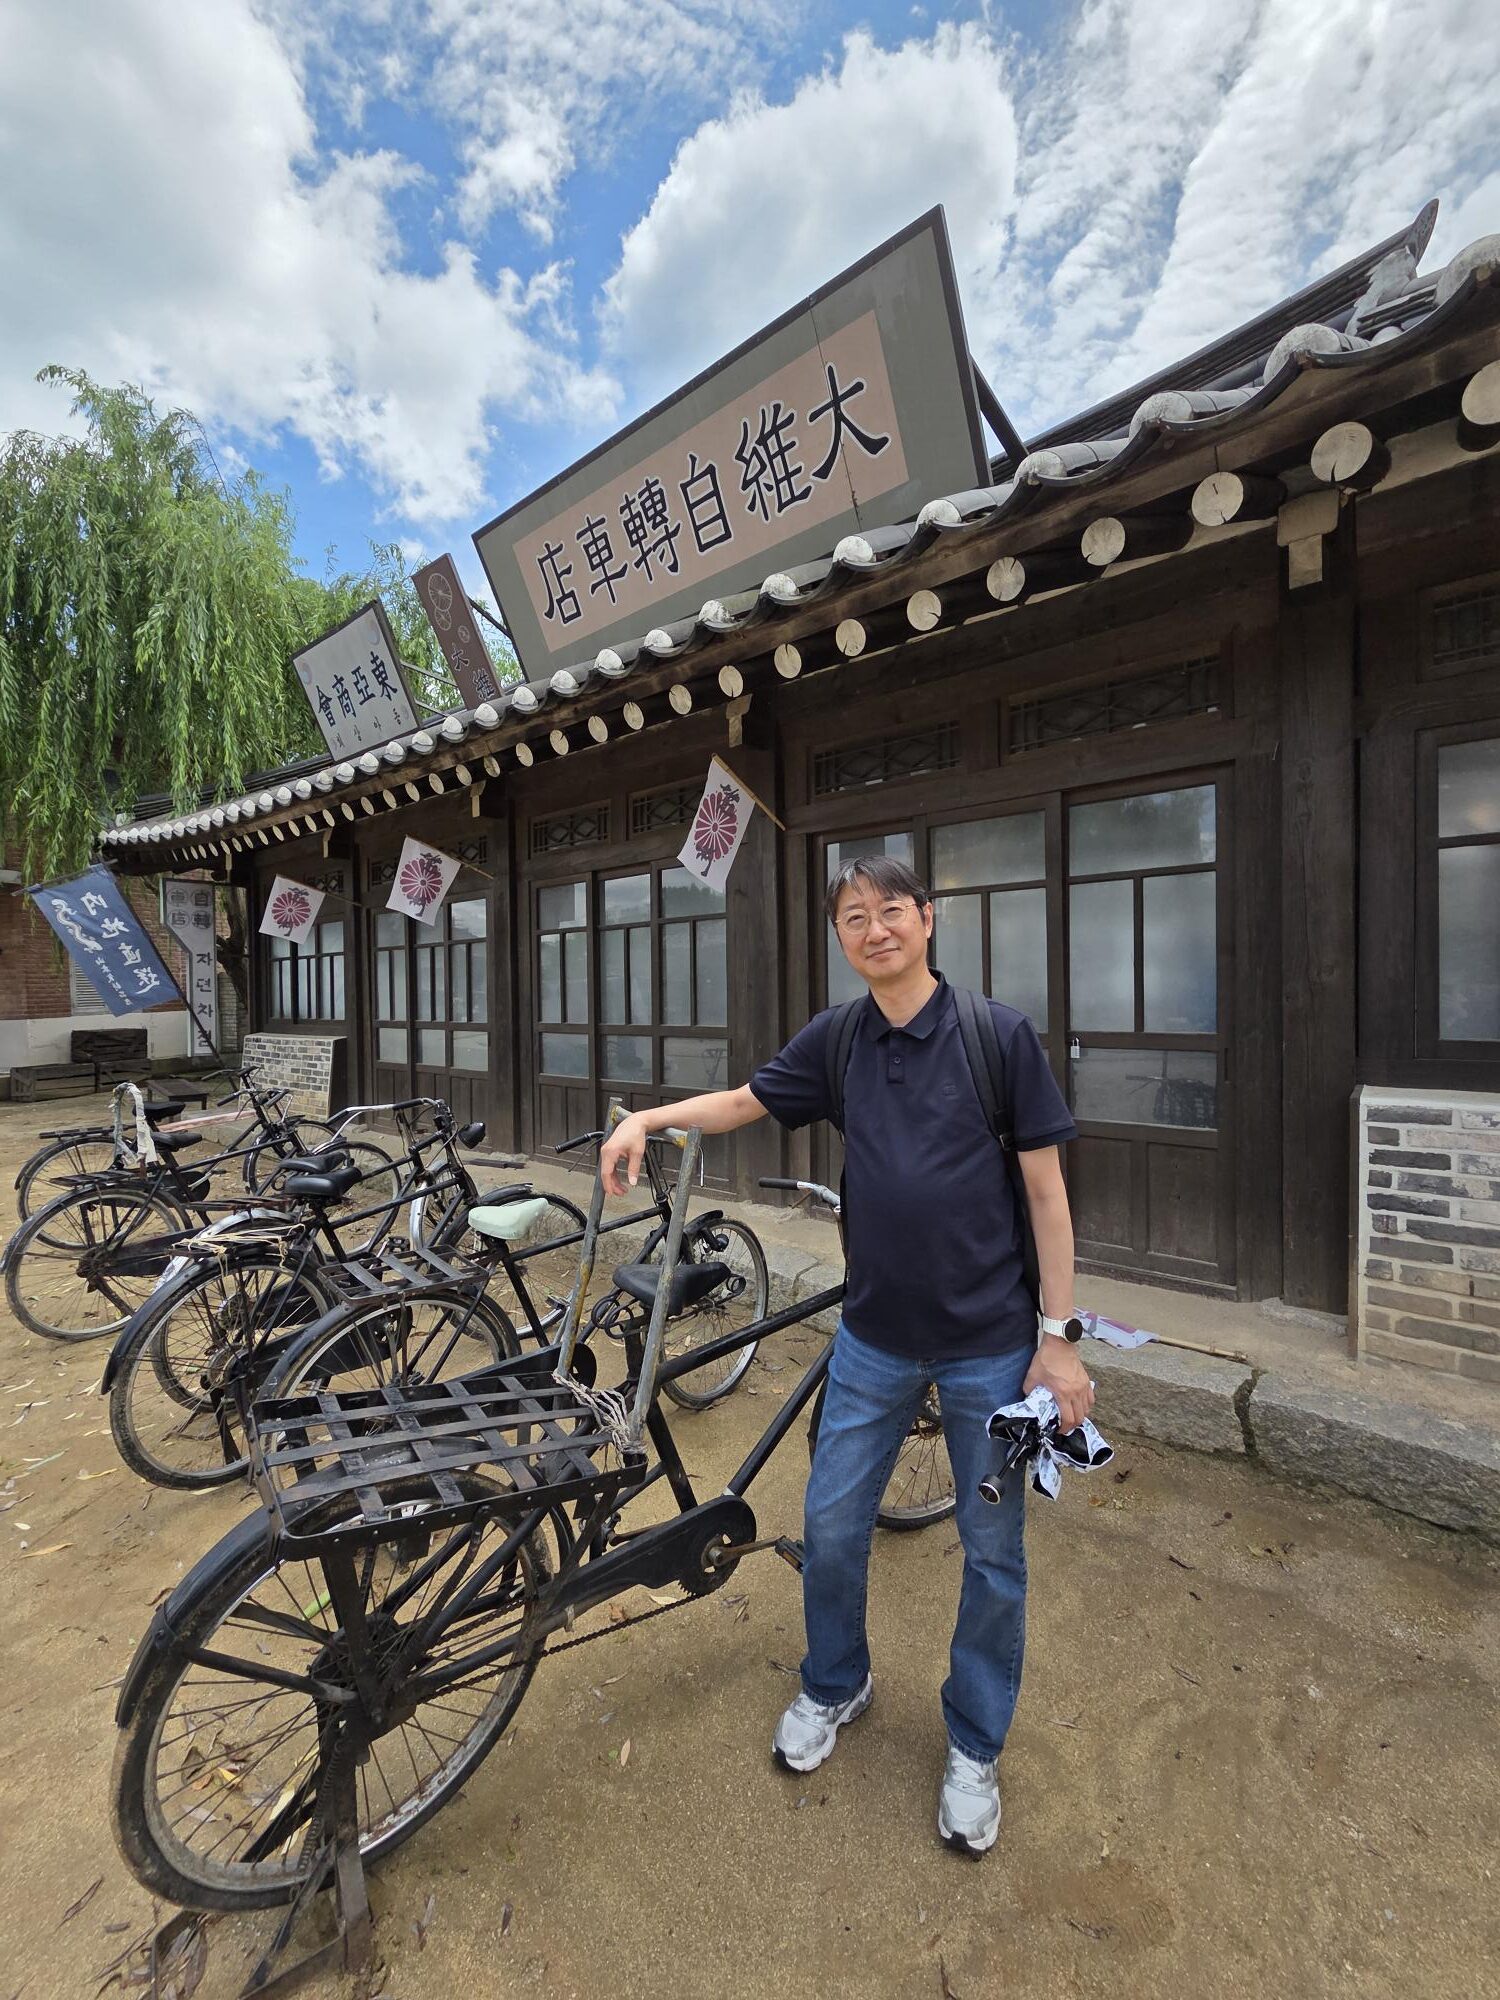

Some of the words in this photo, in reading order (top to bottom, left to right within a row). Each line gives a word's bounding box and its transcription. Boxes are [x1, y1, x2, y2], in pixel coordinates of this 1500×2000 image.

[538, 365, 889, 625] 大維自轉車店
[315, 651, 398, 727] 東亞商會
